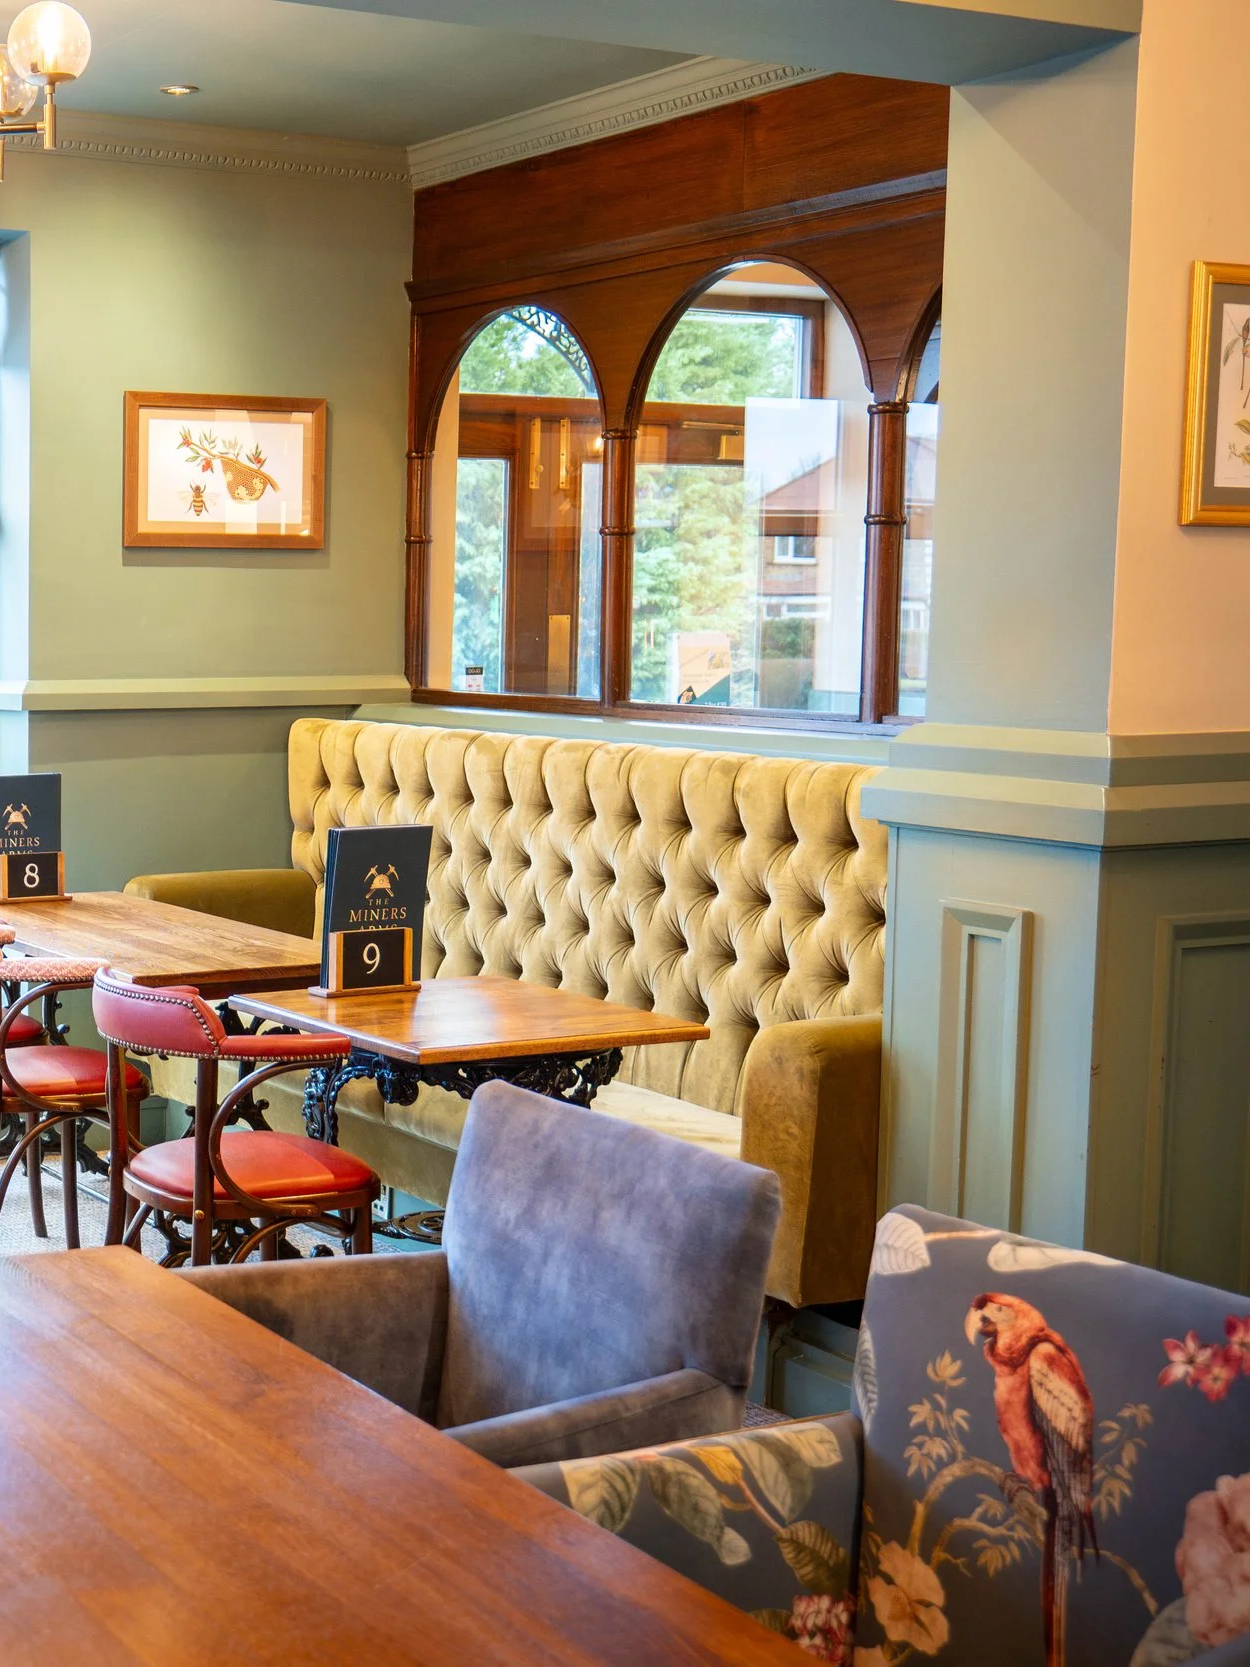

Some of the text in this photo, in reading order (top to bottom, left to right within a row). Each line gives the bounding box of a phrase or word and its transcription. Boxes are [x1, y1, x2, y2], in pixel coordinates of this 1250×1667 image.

[23, 863, 40, 888] 8
[368, 898, 389, 906] THE
[349, 906, 407, 923] MINERS
[363, 943, 381, 974] 9
